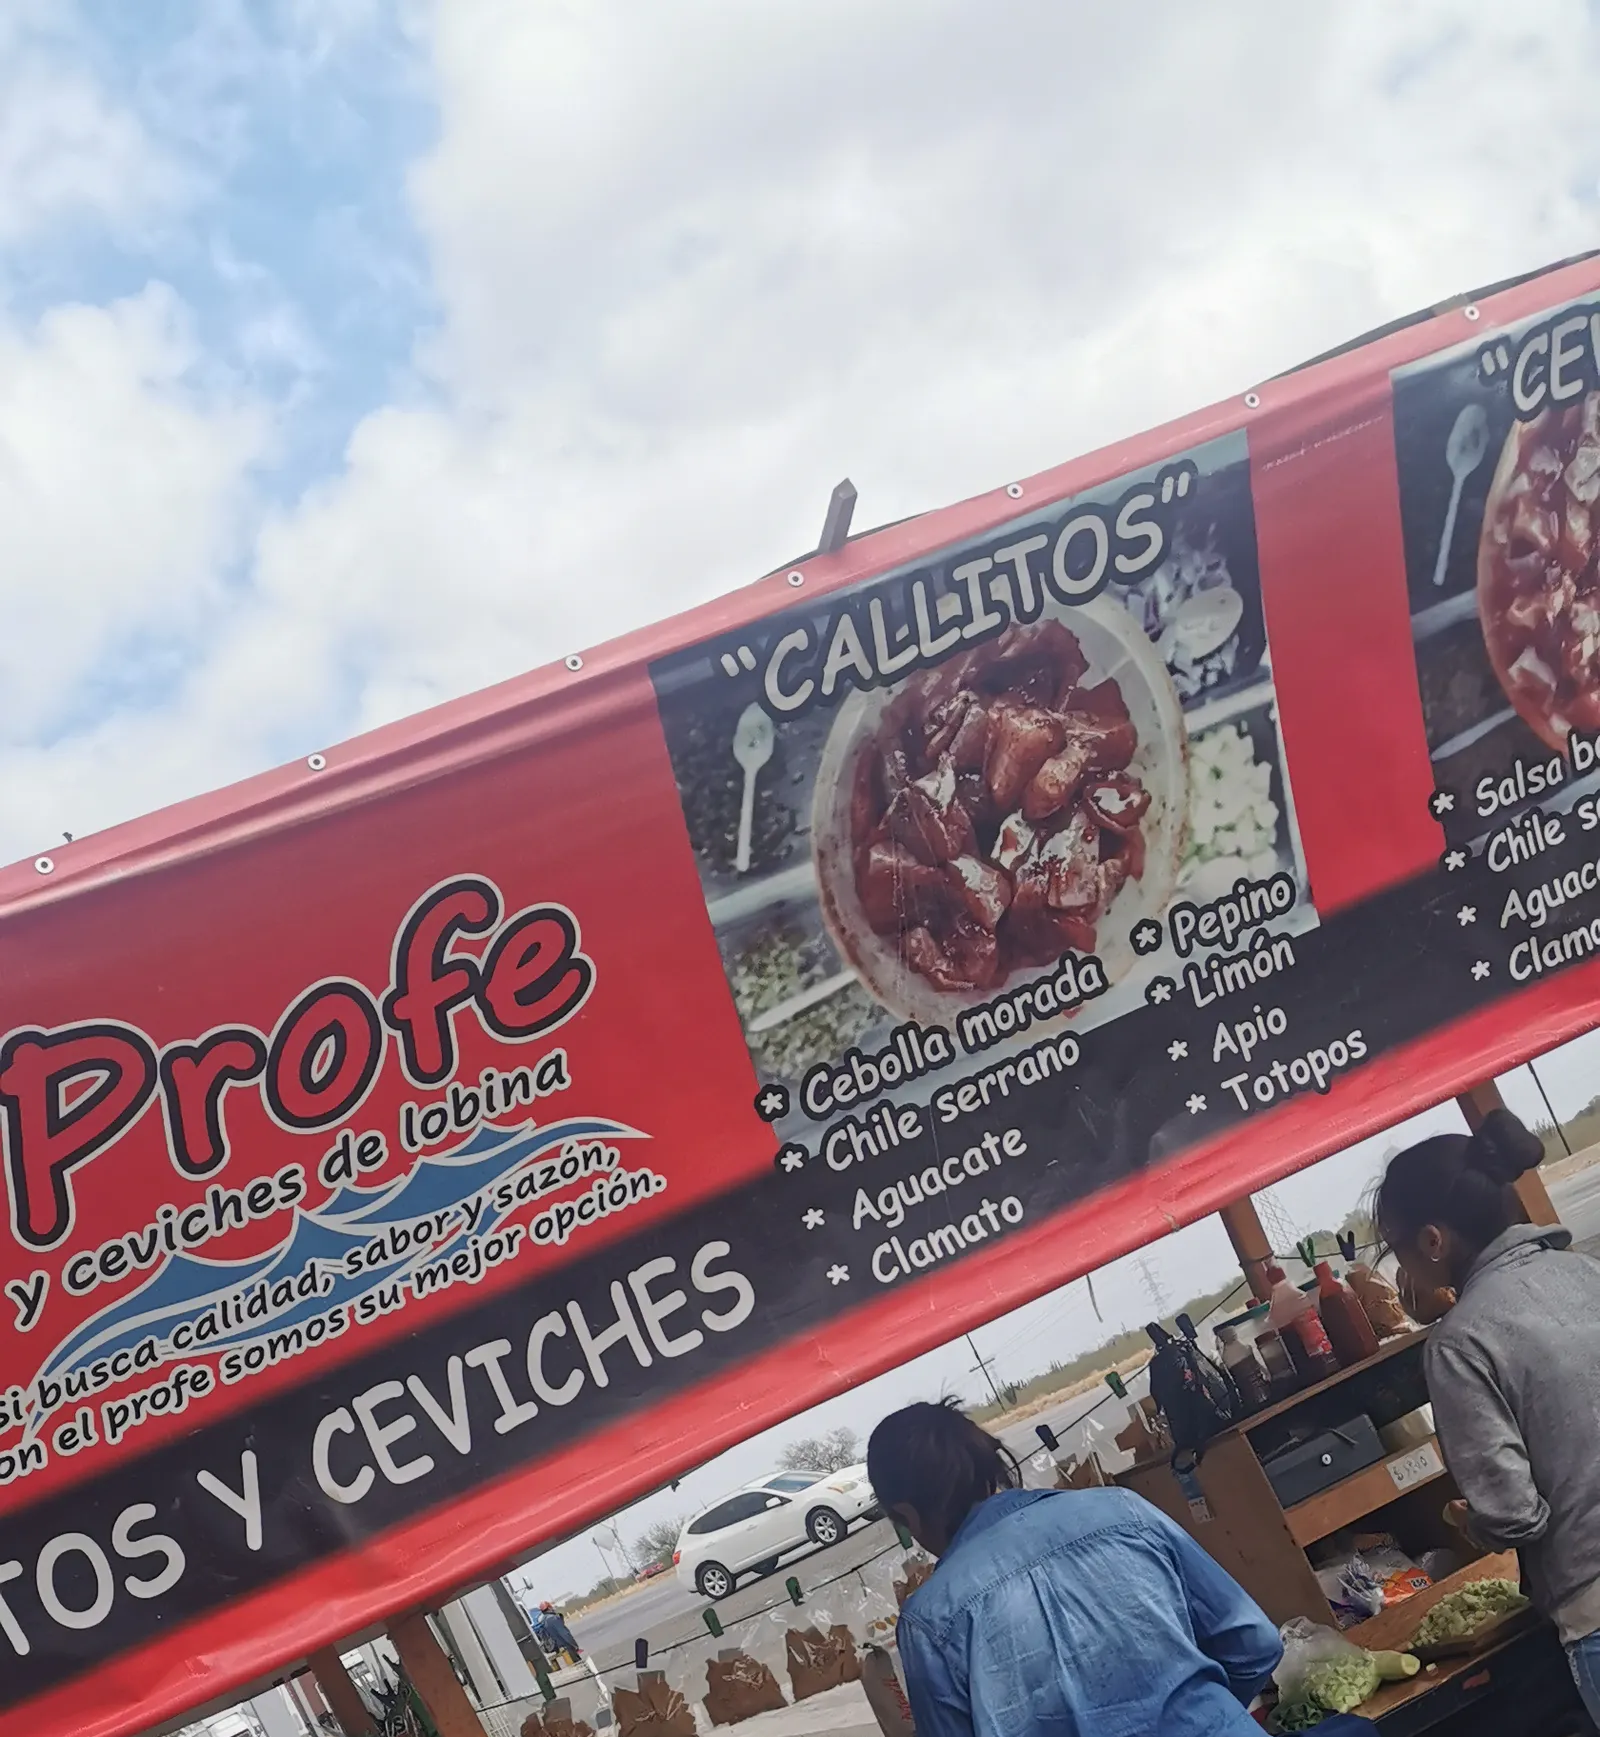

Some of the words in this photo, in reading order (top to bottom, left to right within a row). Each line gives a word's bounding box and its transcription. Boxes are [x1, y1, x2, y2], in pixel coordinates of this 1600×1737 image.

[720, 472, 1190, 711] "CALLITOS"
[1476, 759, 1563, 817] Salsa
[1487, 814, 1566, 872] Chile
[1174, 879, 1291, 950] Pepino
[1500, 860, 1600, 929] Aguac
[1188, 935, 1296, 1008] Limón
[0, 877, 593, 1247] Profe
[806, 1029, 950, 1113] Cebolla
[962, 958, 1103, 1046] morada
[1212, 1005, 1287, 1063] Apio
[1220, 1029, 1368, 1111] Totopos
[826, 1107, 924, 1171] Chile
[937, 1037, 1080, 1122] serrano
[11, 1275, 44, 1327] y
[68, 1167, 304, 1290] ceviches
[324, 1134, 384, 1183] de
[406, 1053, 567, 1147] lobina
[852, 1128, 1028, 1230] Aguacate
[38, 1339, 157, 1409] busca
[173, 1262, 331, 1350] calidad,
[346, 1209, 451, 1274] sabor
[462, 1196, 482, 1230] y
[497, 1142, 615, 1208] sazón,
[871, 1196, 1024, 1284] Clamato
[58, 1411, 93, 1450] el
[107, 1369, 210, 1439] profe
[224, 1308, 345, 1379] somos
[359, 1283, 400, 1319] su
[415, 1229, 522, 1294] mejor
[534, 1170, 662, 1243] opción.
[197, 1450, 264, 1551] Y
[313, 1241, 756, 1503] CEVICHES
